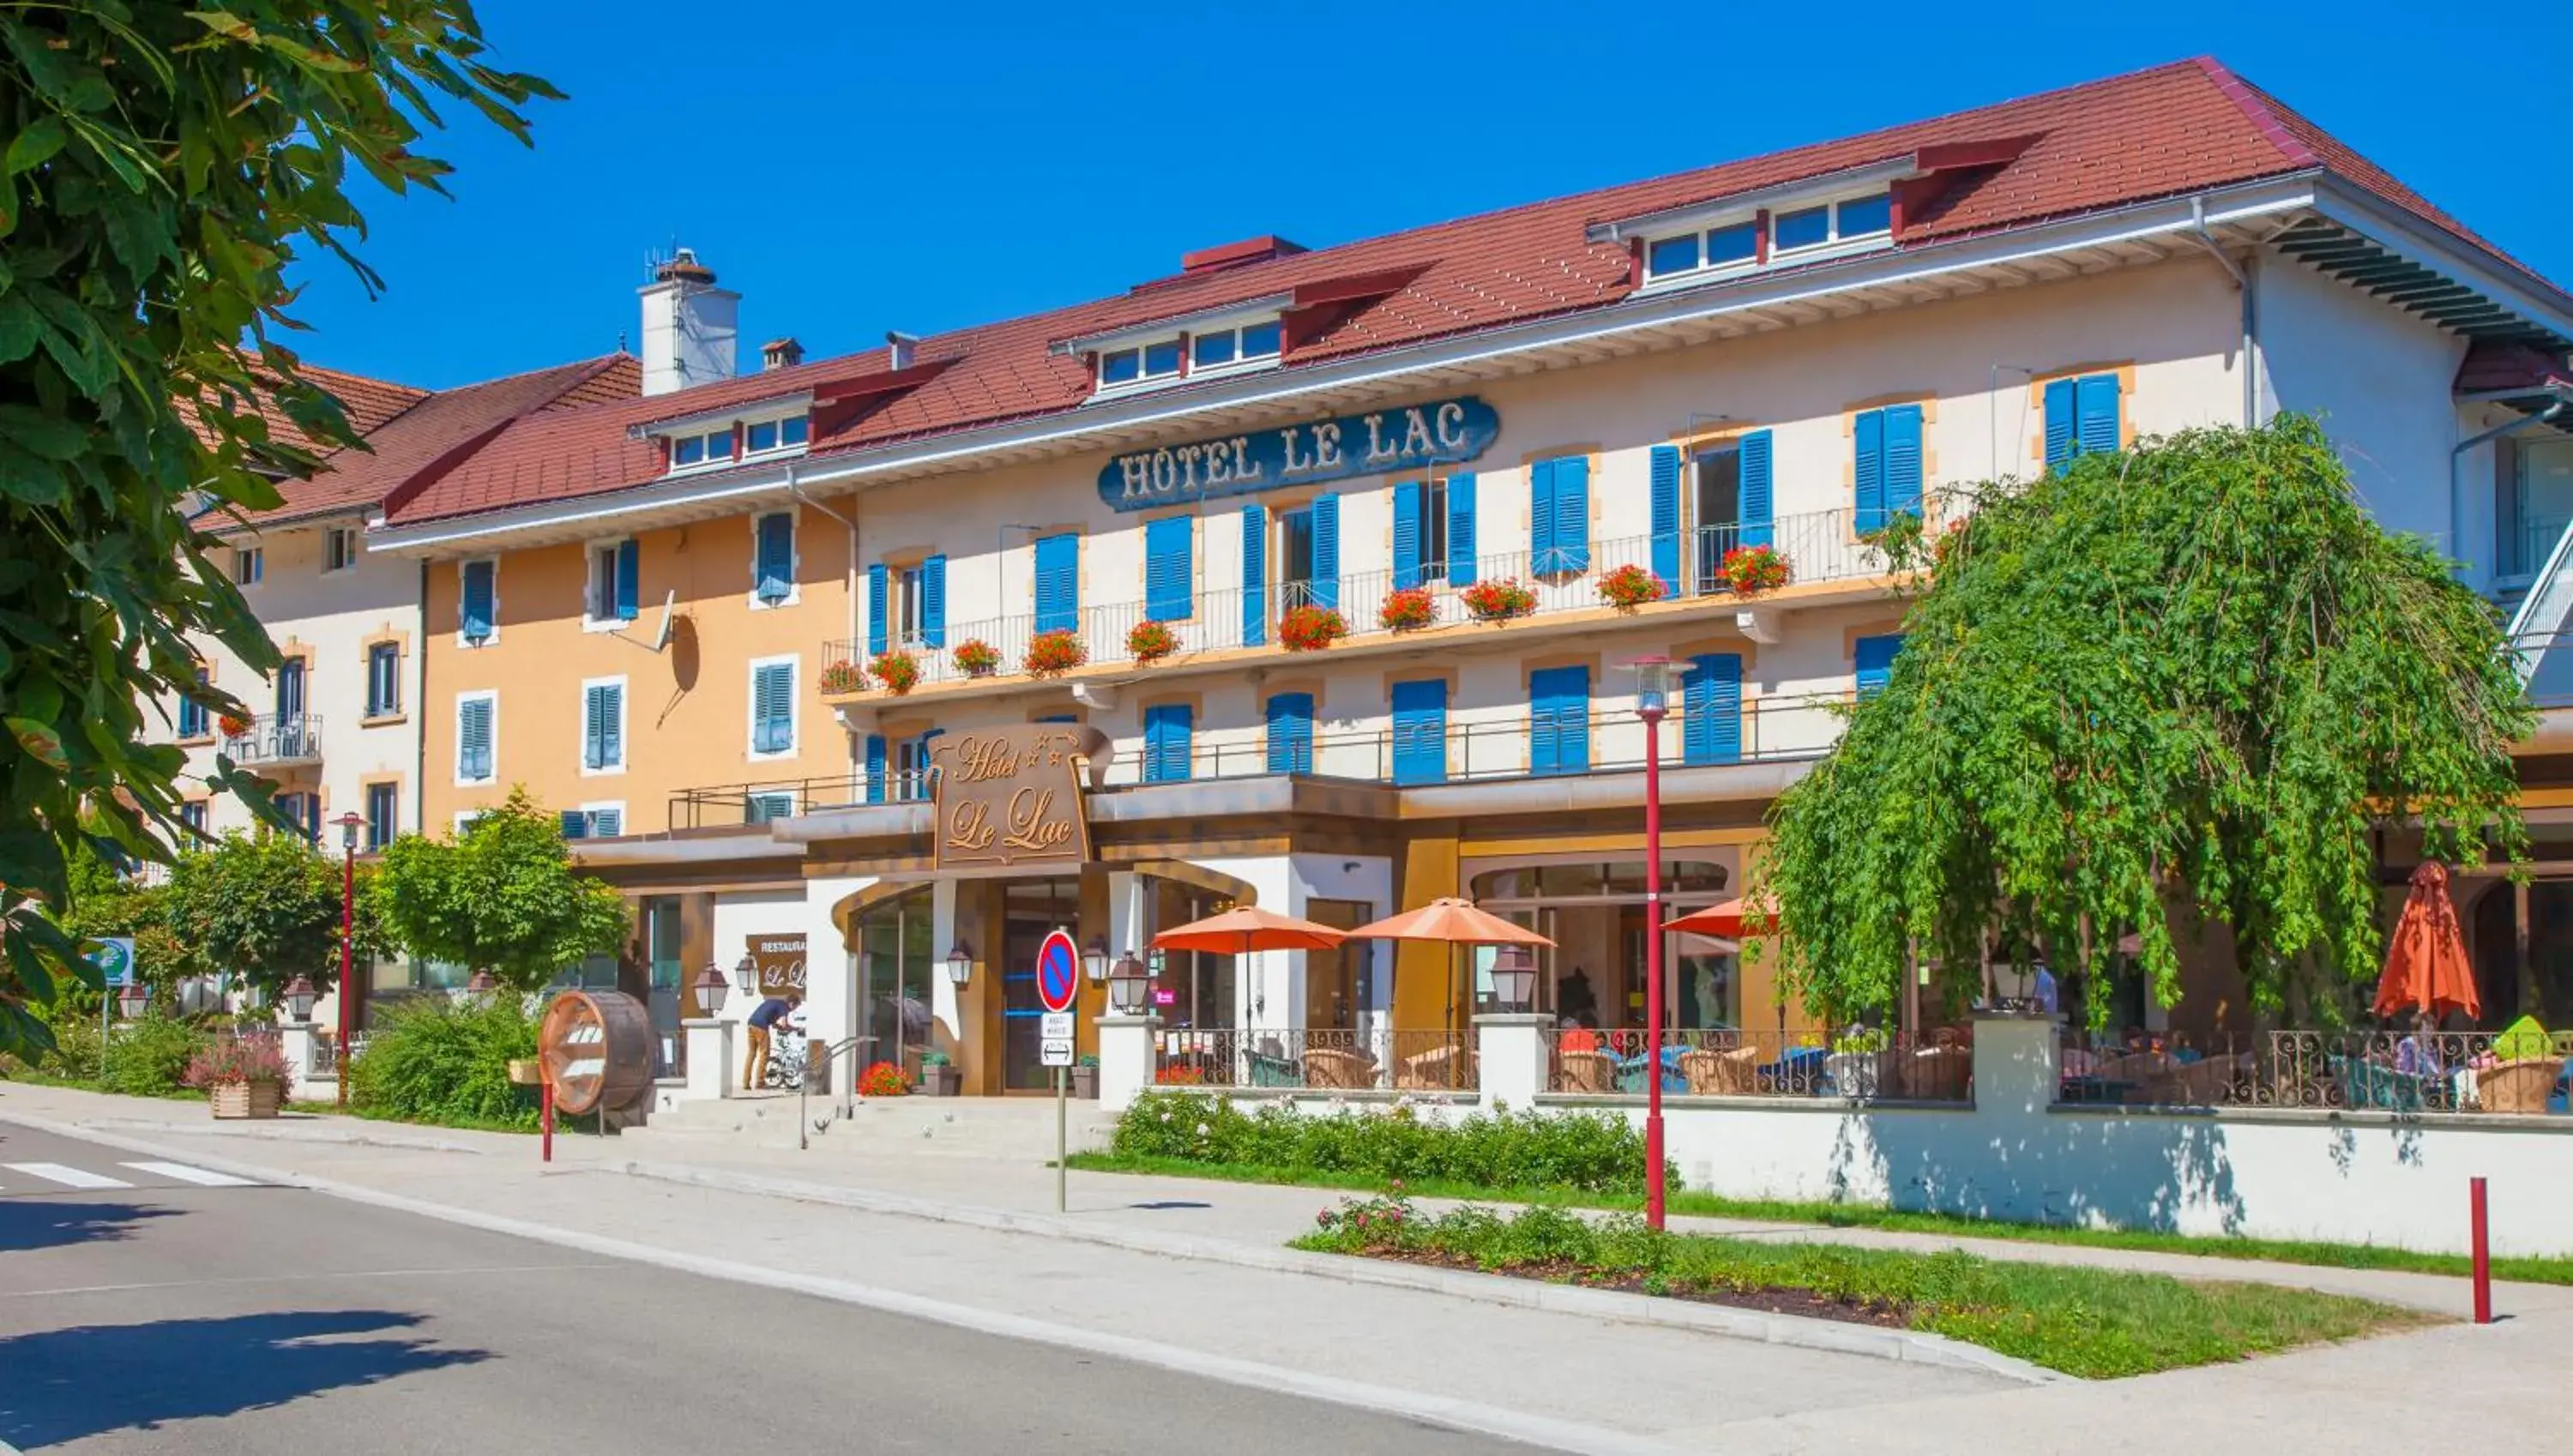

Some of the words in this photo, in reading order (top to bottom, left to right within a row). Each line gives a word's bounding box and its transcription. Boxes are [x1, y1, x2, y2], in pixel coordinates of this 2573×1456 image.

[1280, 423, 1341, 475] LE
[1364, 402, 1464, 462] LAC
[946, 799, 997, 851] Le
[1001, 786, 1073, 851] Lac
